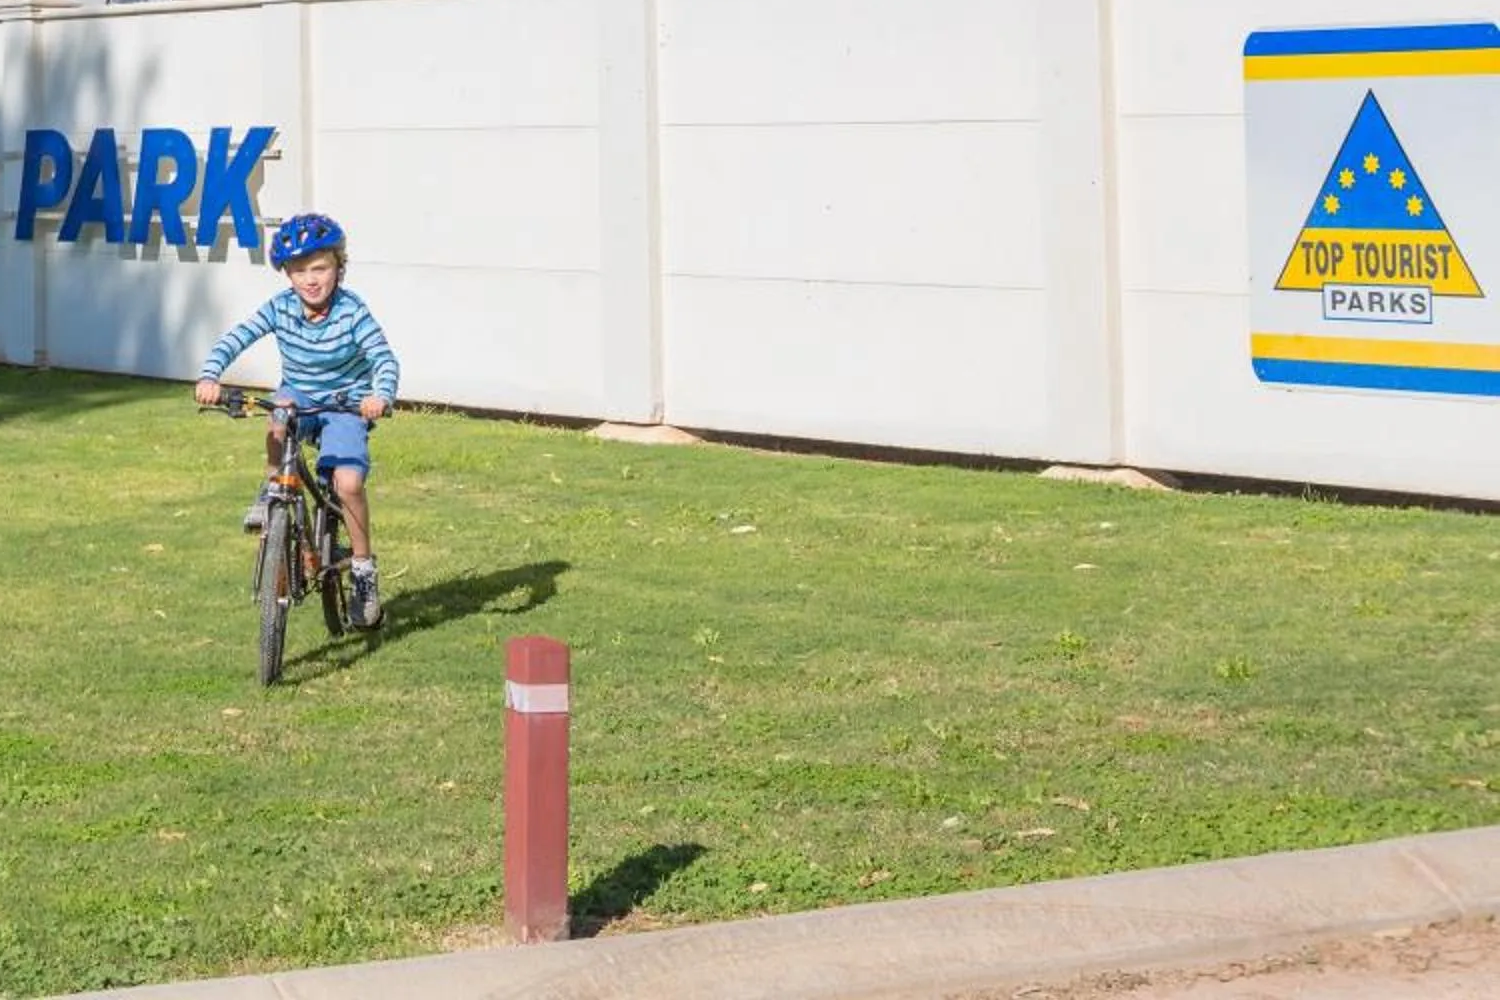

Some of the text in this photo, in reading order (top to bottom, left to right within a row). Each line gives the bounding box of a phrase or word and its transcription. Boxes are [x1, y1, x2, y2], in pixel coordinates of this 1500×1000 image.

[14, 126, 277, 249] PARK
[1300, 241, 1453, 281] TOP TOURIST
[1330, 289, 1428, 315] PARKS
